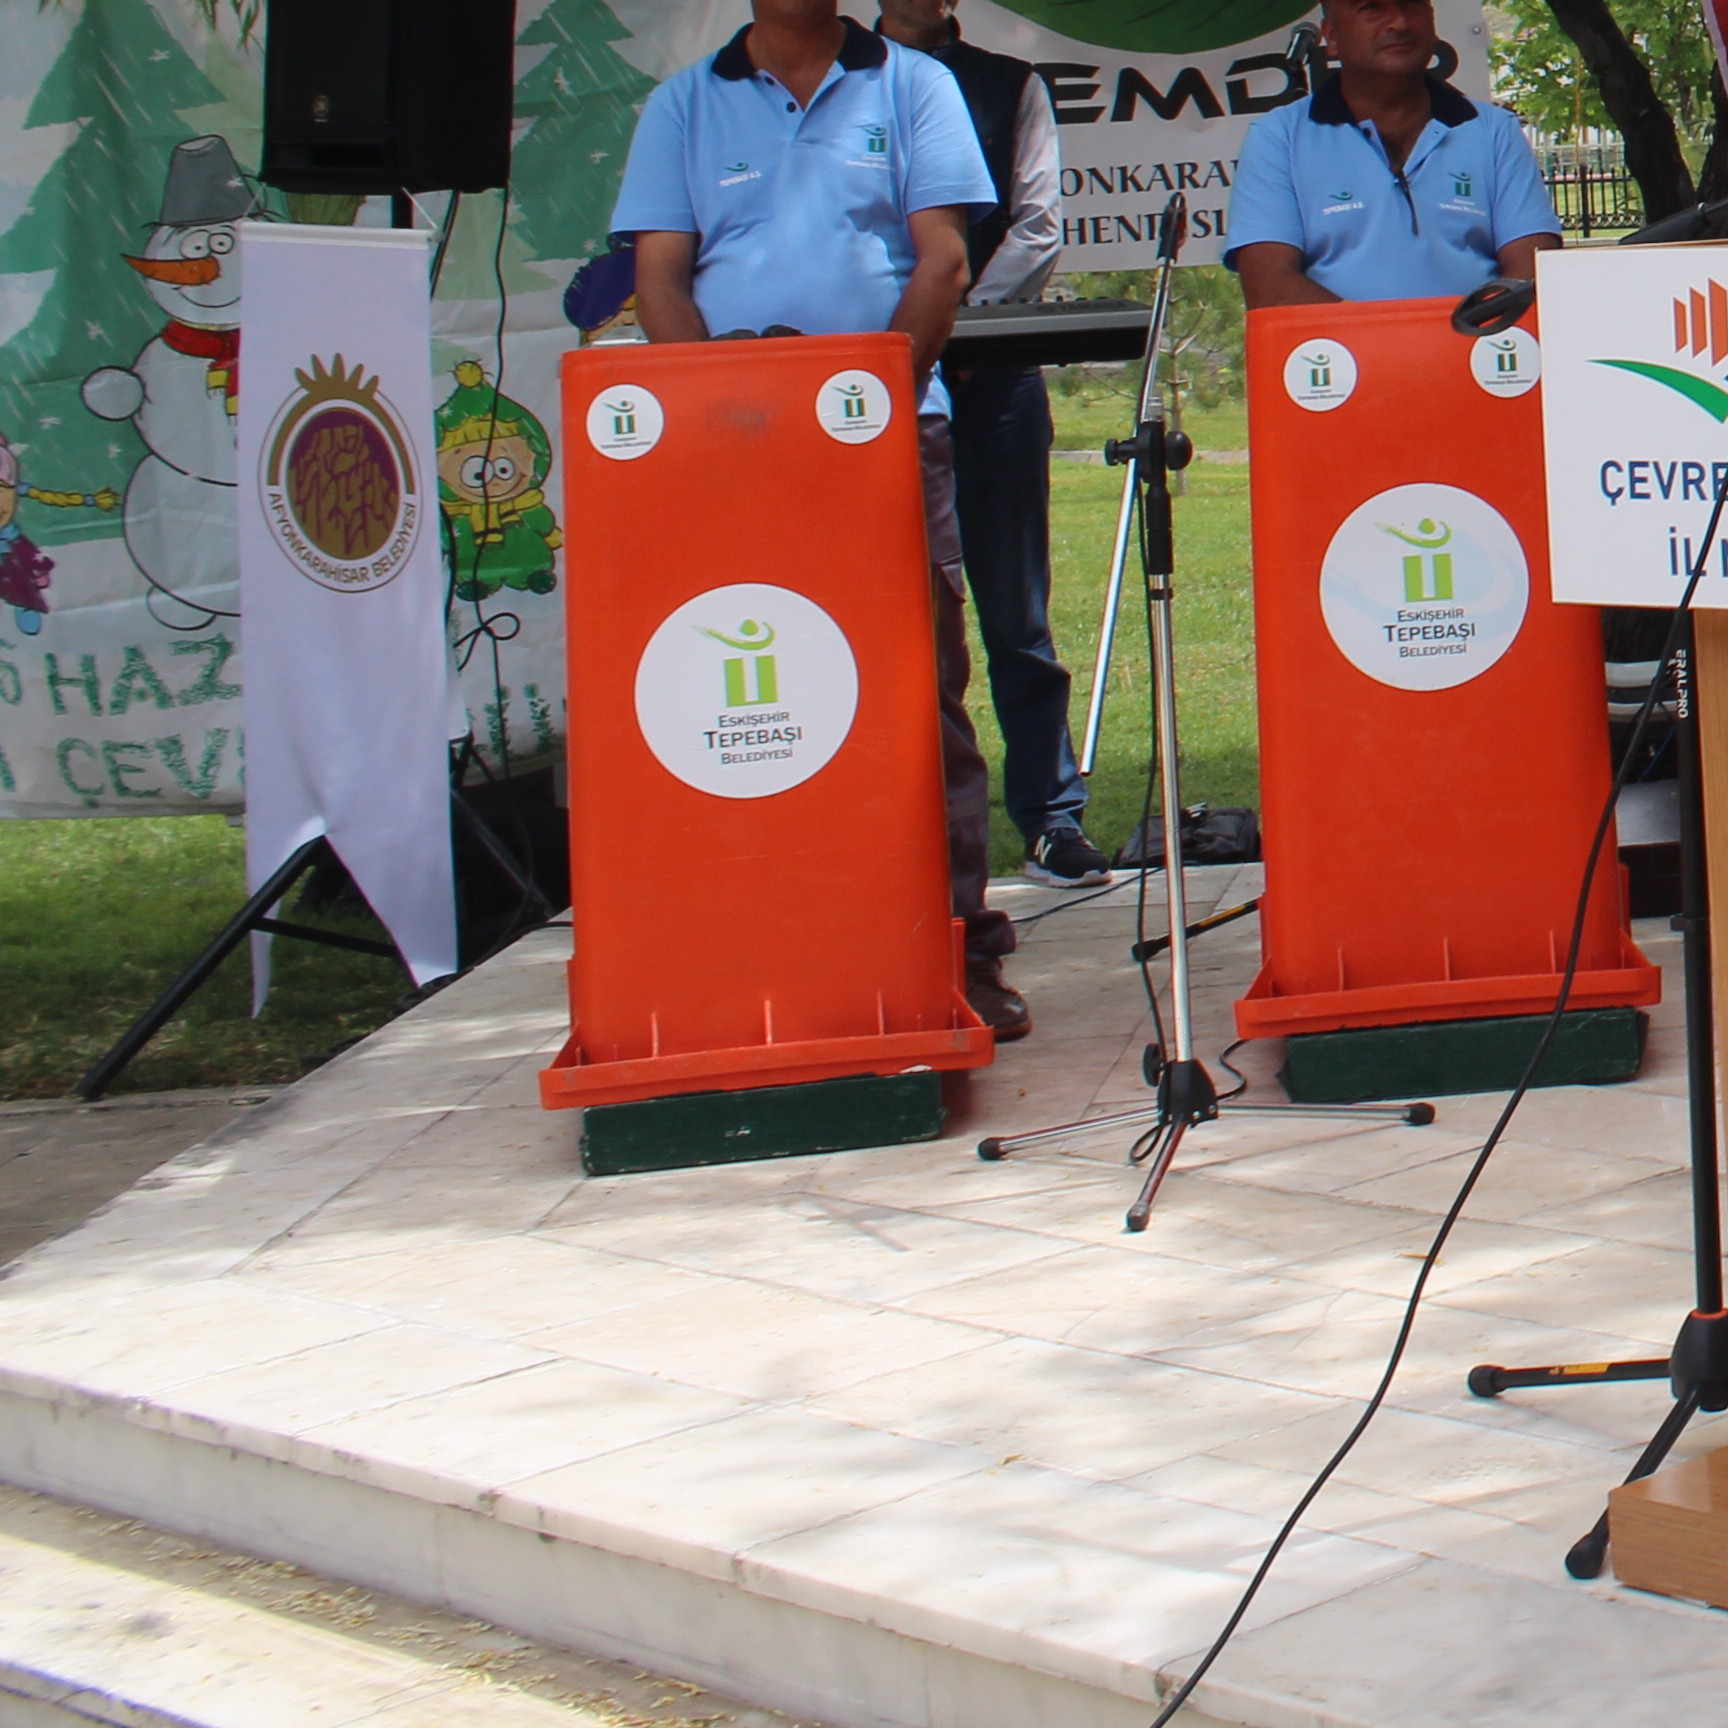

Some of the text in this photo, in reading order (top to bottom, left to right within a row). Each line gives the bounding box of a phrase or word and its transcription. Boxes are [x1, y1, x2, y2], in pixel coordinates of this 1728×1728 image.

[1060, 158, 1239, 197] ONKARA
[267, 492, 417, 584] AFYONKARAHİSAR BELEDİYESİ
[1668, 526, 1707, 577] İL
[1397, 608, 1465, 623] ESKİŞEHİR
[1383, 622, 1476, 642] TEPEBAŞI
[1399, 643, 1467, 658] BELEDİYESİ
[718, 711, 790, 728] ESKİŞEHİR
[702, 726, 802, 749] TEPEBAŞI
[720, 747, 793, 765] BELEDİYESİ
[56, 726, 246, 809] ÇEV
